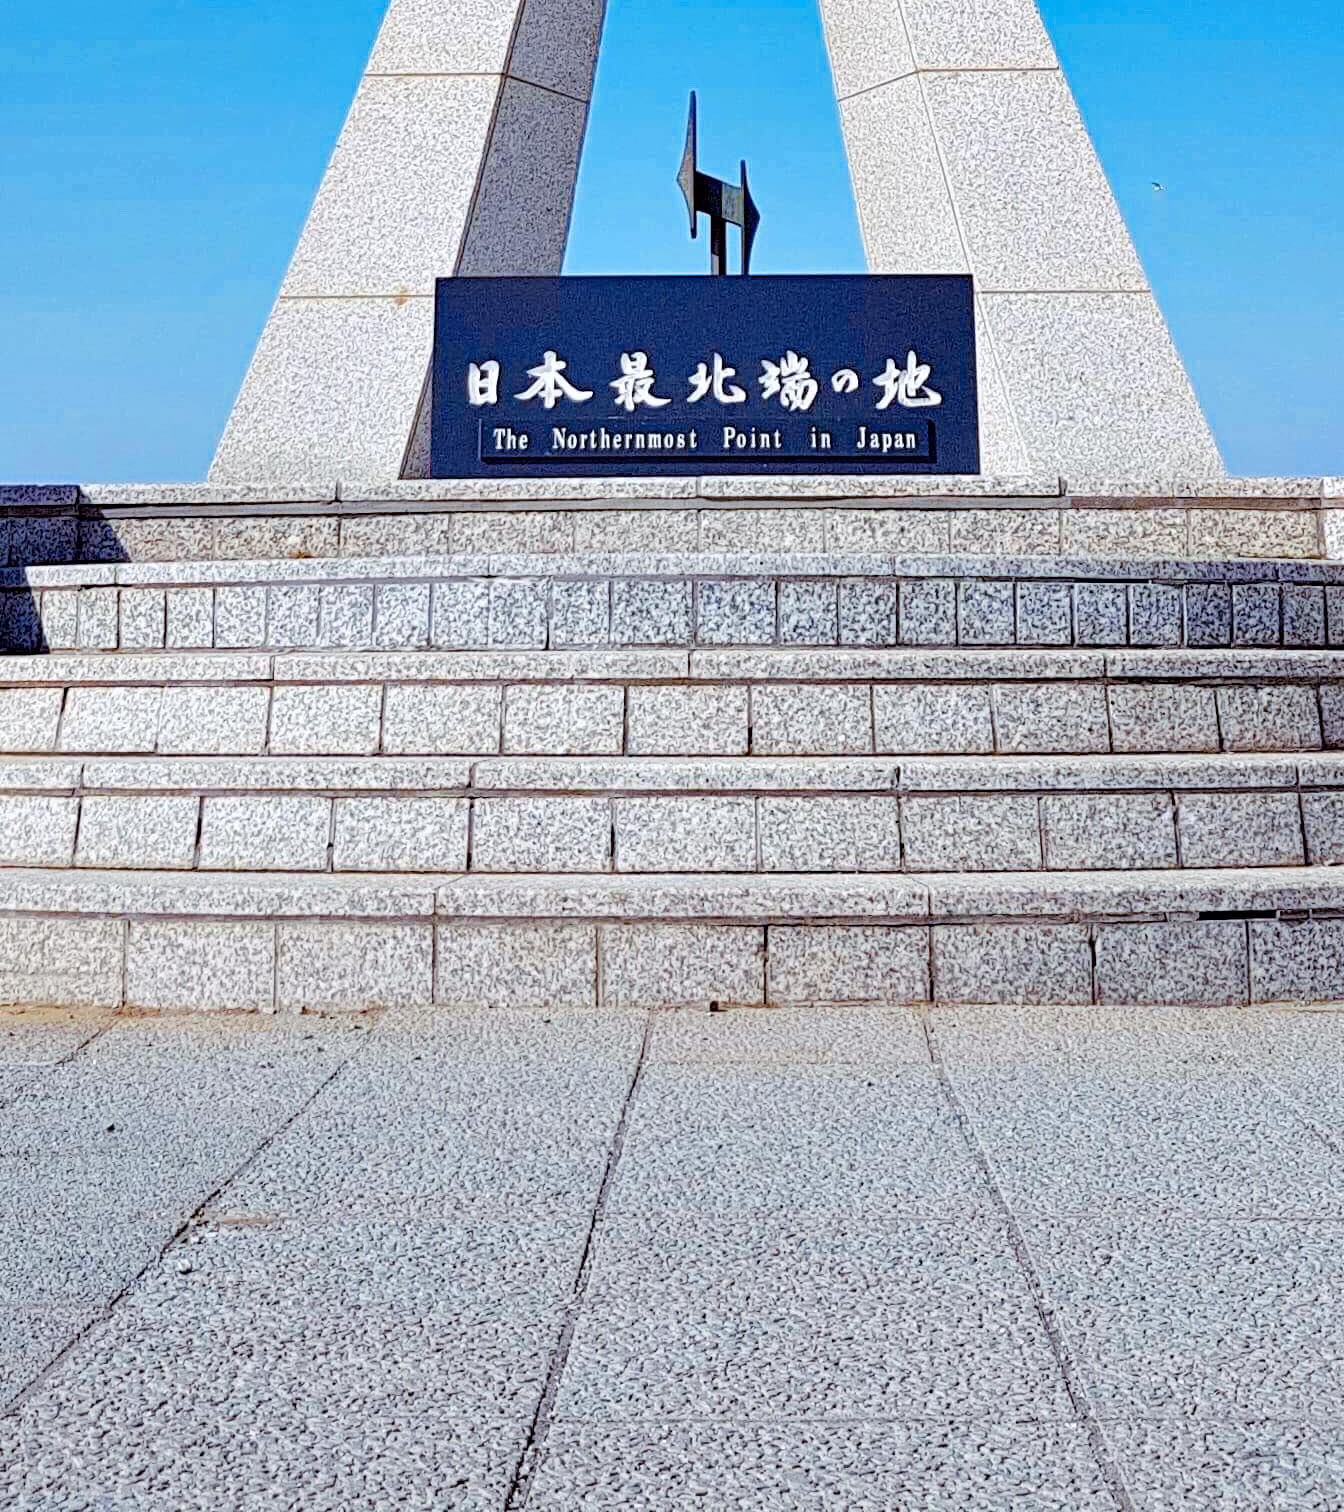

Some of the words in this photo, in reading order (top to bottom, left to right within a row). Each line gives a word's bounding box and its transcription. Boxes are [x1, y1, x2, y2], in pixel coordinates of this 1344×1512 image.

[467, 350, 942, 412] 日本最北端の地
[492, 428, 529, 450] The
[551, 427, 698, 450] Northernmost
[723, 426, 782, 449] Point
[810, 426, 832, 449] in
[856, 426, 916, 453] Japan
